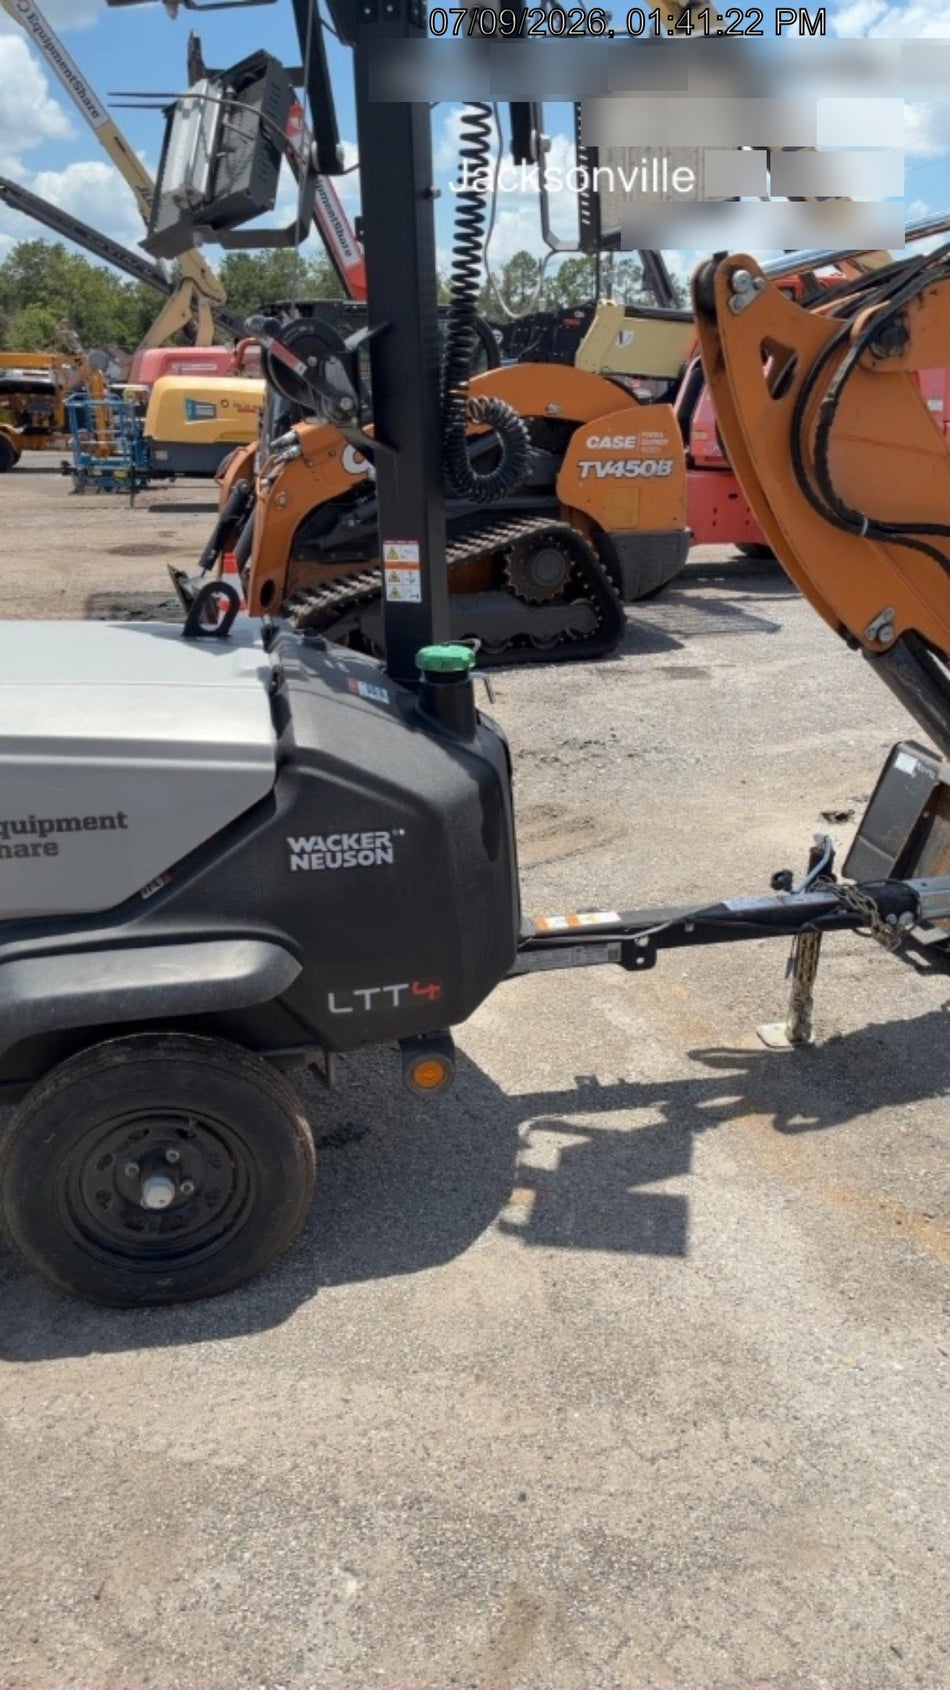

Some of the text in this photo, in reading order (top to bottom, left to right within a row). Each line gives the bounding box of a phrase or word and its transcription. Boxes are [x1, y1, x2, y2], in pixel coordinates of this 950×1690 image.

[27, 12, 100, 119] EquipmentShare
[585, 434, 637, 450] CASE
[578, 459, 674, 479] TV450B
[286, 831, 393, 853] WACKER
[290, 848, 393, 871] NEUSON
[327, 981, 440, 1013] LTT4
